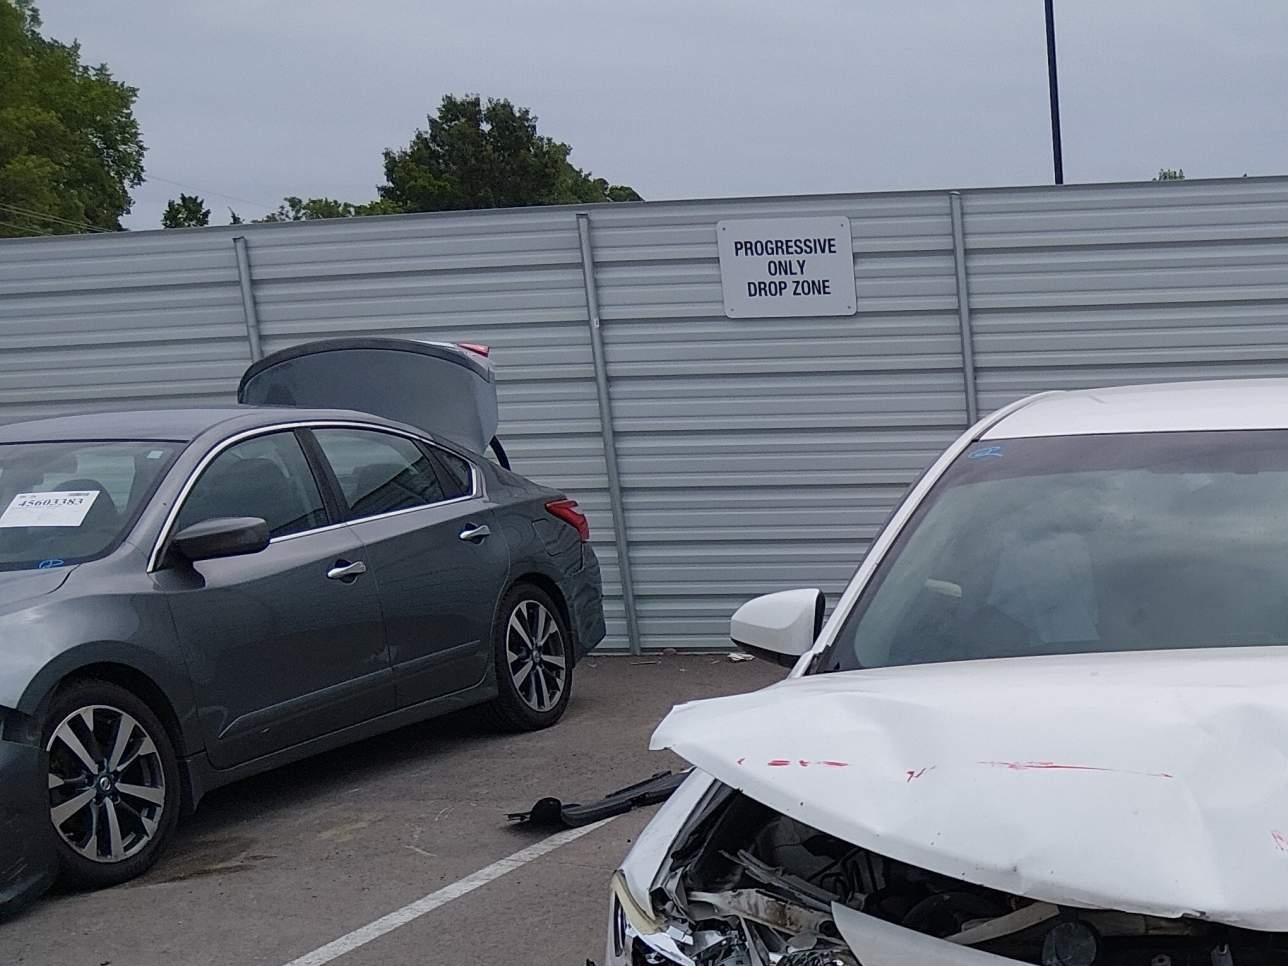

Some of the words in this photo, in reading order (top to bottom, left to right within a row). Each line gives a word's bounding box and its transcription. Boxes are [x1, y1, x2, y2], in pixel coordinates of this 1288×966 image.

[734, 238, 837, 256] PROGRESSIVE
[767, 259, 806, 276] ONLY
[747, 281, 787, 297] DROP
[792, 280, 831, 296] ZONE
